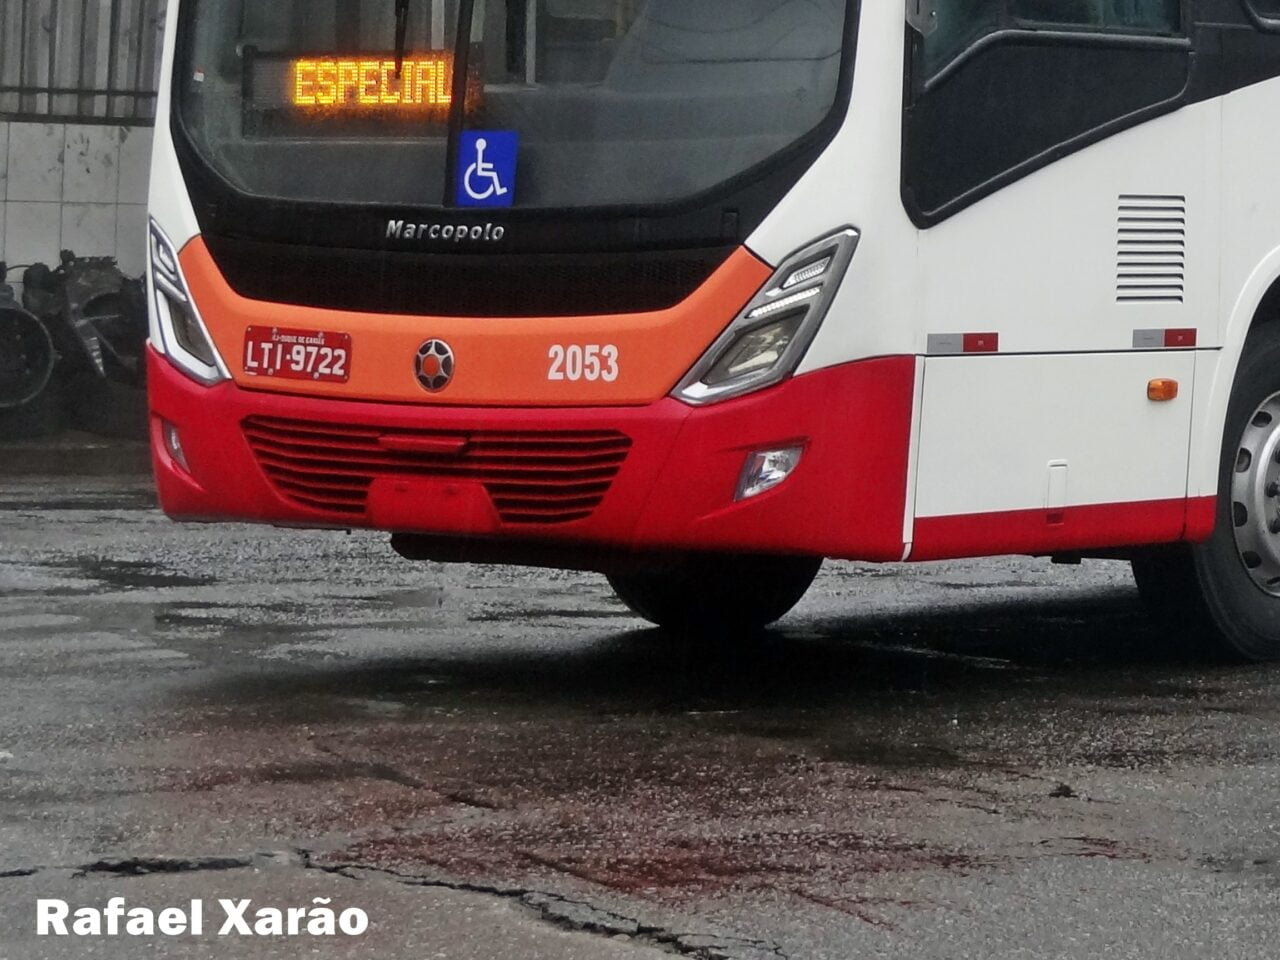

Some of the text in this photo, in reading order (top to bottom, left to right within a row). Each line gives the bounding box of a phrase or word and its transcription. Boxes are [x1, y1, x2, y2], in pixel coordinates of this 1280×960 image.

[295, 60, 452, 104] ESPECIAL
[385, 219, 505, 242] Marcopolo
[547, 344, 619, 382] 2053
